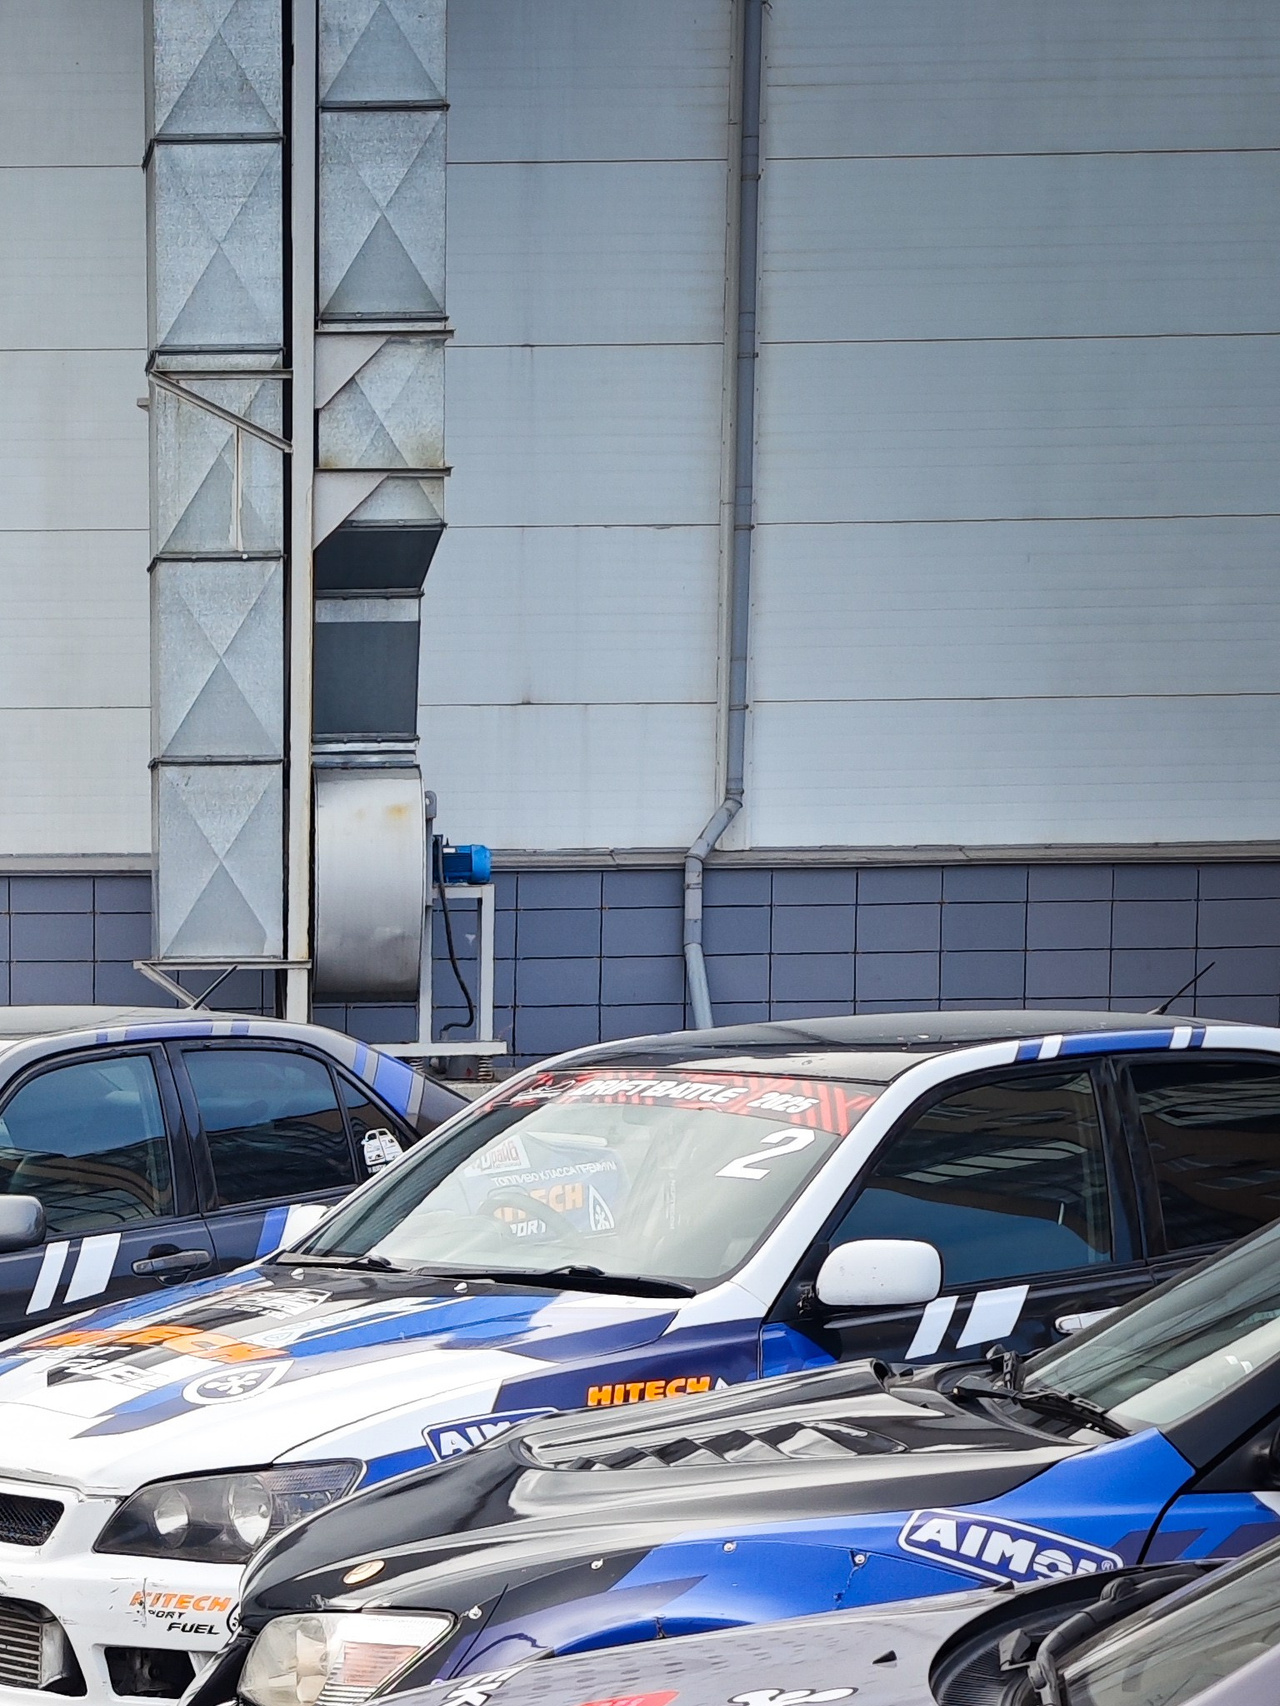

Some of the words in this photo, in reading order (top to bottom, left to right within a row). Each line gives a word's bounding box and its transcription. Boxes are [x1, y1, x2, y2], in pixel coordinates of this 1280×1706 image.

[573, 1080, 660, 1096] DRIFT
[640, 1082, 749, 1103] BATTLE
[747, 1092, 819, 1113] 2025
[715, 1127, 815, 1180] 2
[586, 1376, 711, 1407] HITECH
[166, 1621, 221, 1636] FUEL
